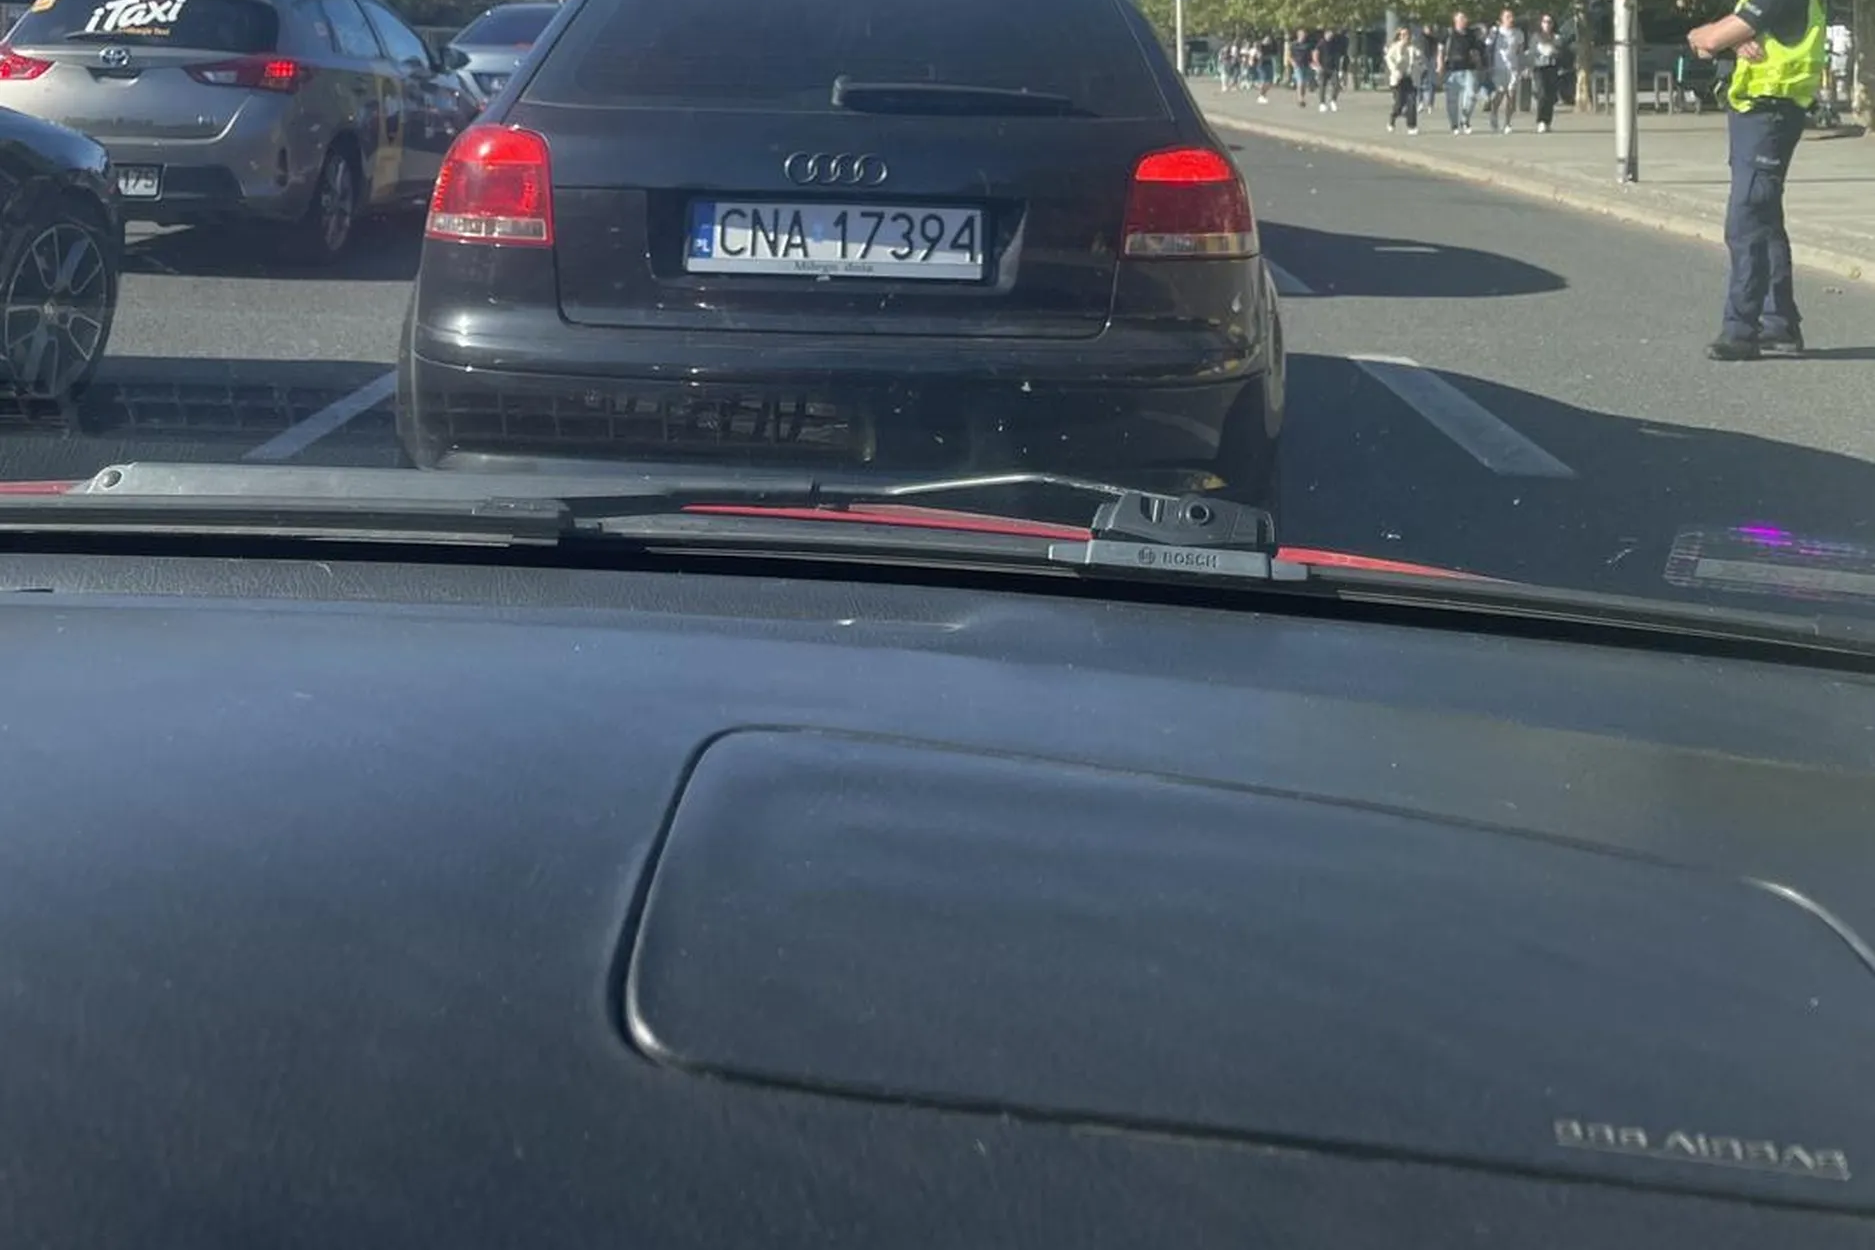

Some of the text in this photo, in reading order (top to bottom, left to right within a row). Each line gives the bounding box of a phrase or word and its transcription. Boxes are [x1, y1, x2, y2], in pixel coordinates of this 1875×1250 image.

[720, 208, 976, 262] CNA 17394
[695, 238, 711, 252] PL
[1162, 551, 1217, 568] BOSCH
